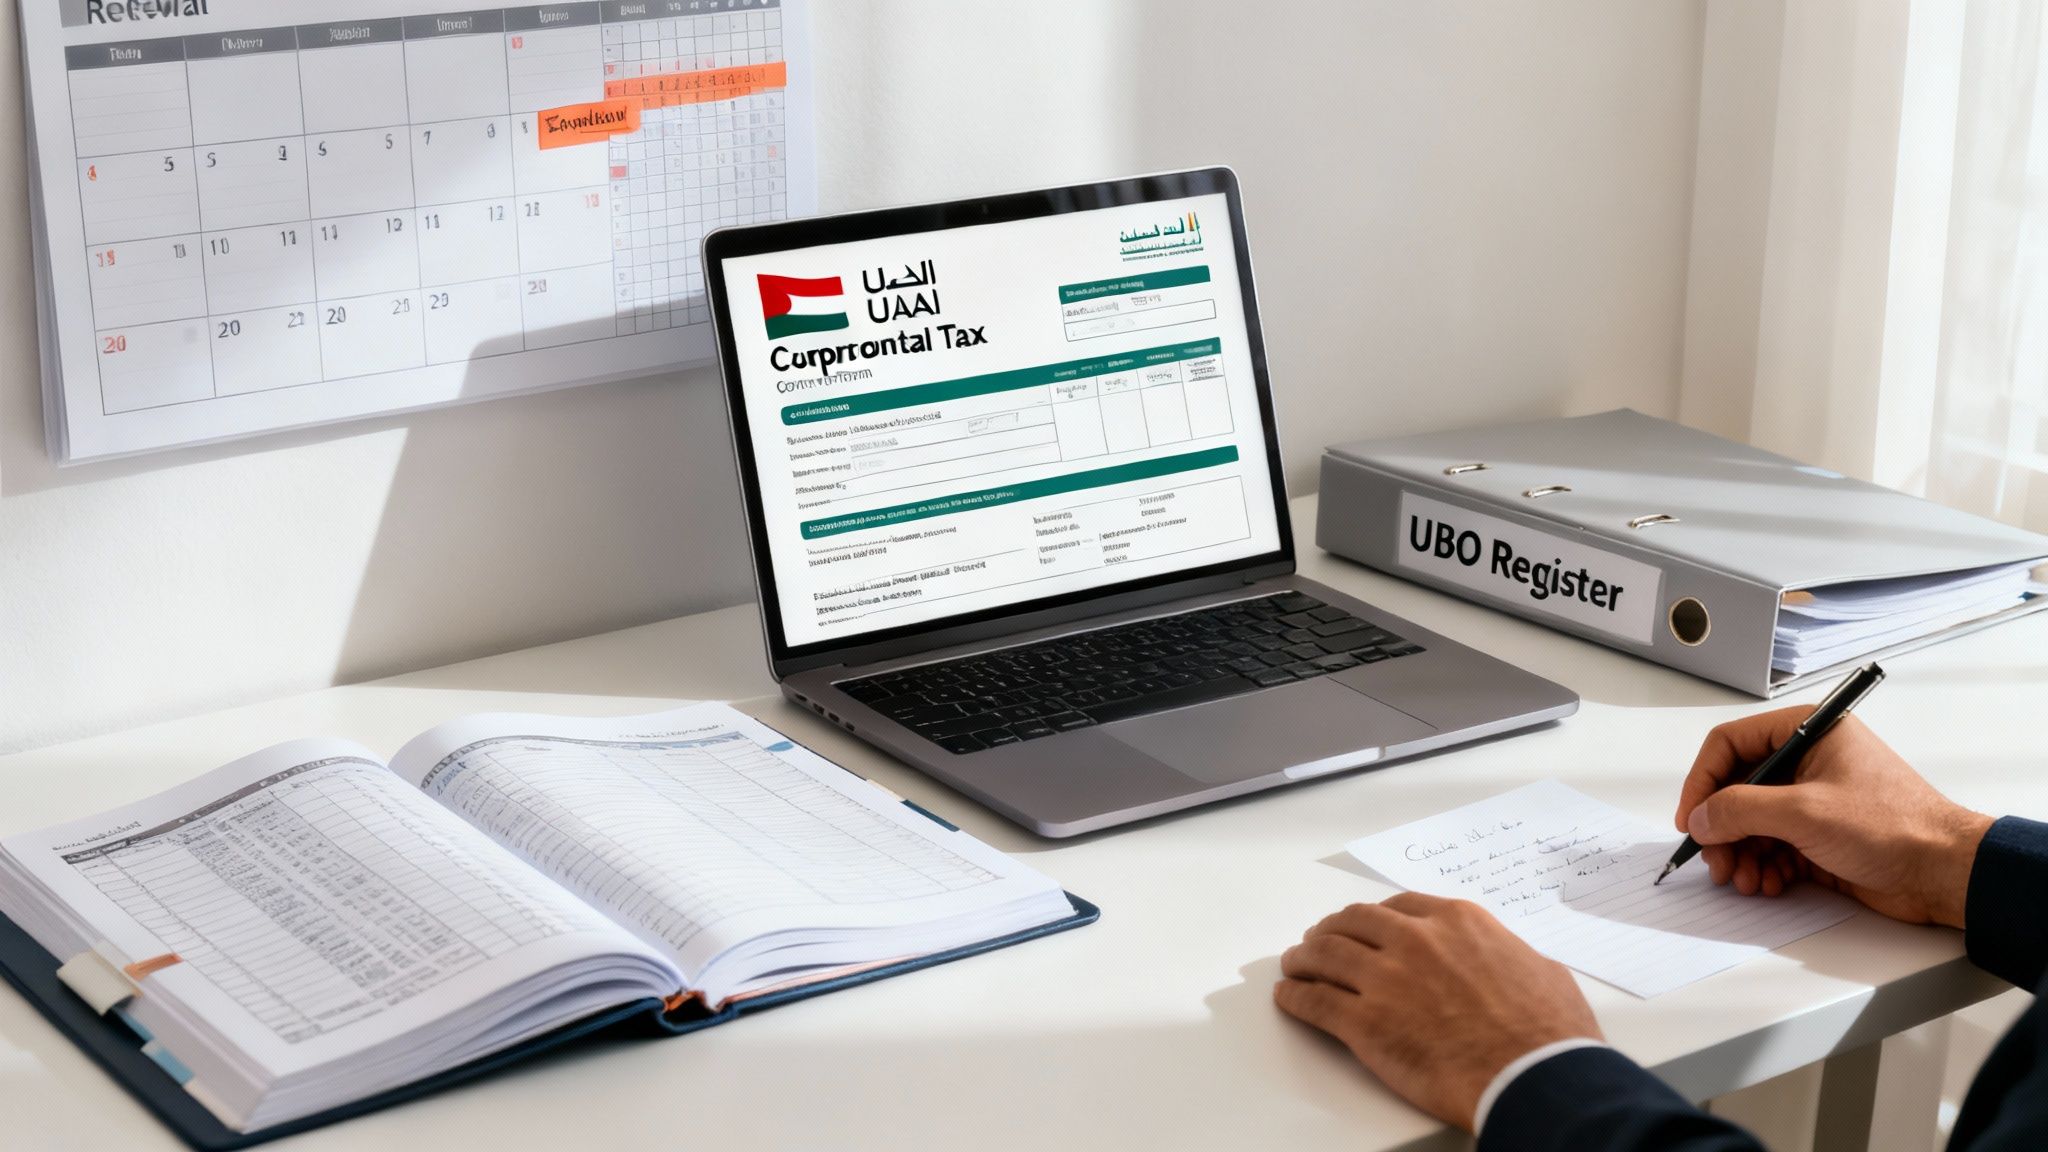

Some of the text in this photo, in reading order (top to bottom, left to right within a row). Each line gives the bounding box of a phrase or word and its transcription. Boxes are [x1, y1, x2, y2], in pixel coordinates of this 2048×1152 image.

[164, 156, 174, 172] 5
[218, 319, 241, 338] 20
[936, 324, 988, 350] Tax
[1410, 515, 1624, 612] UBO Register
